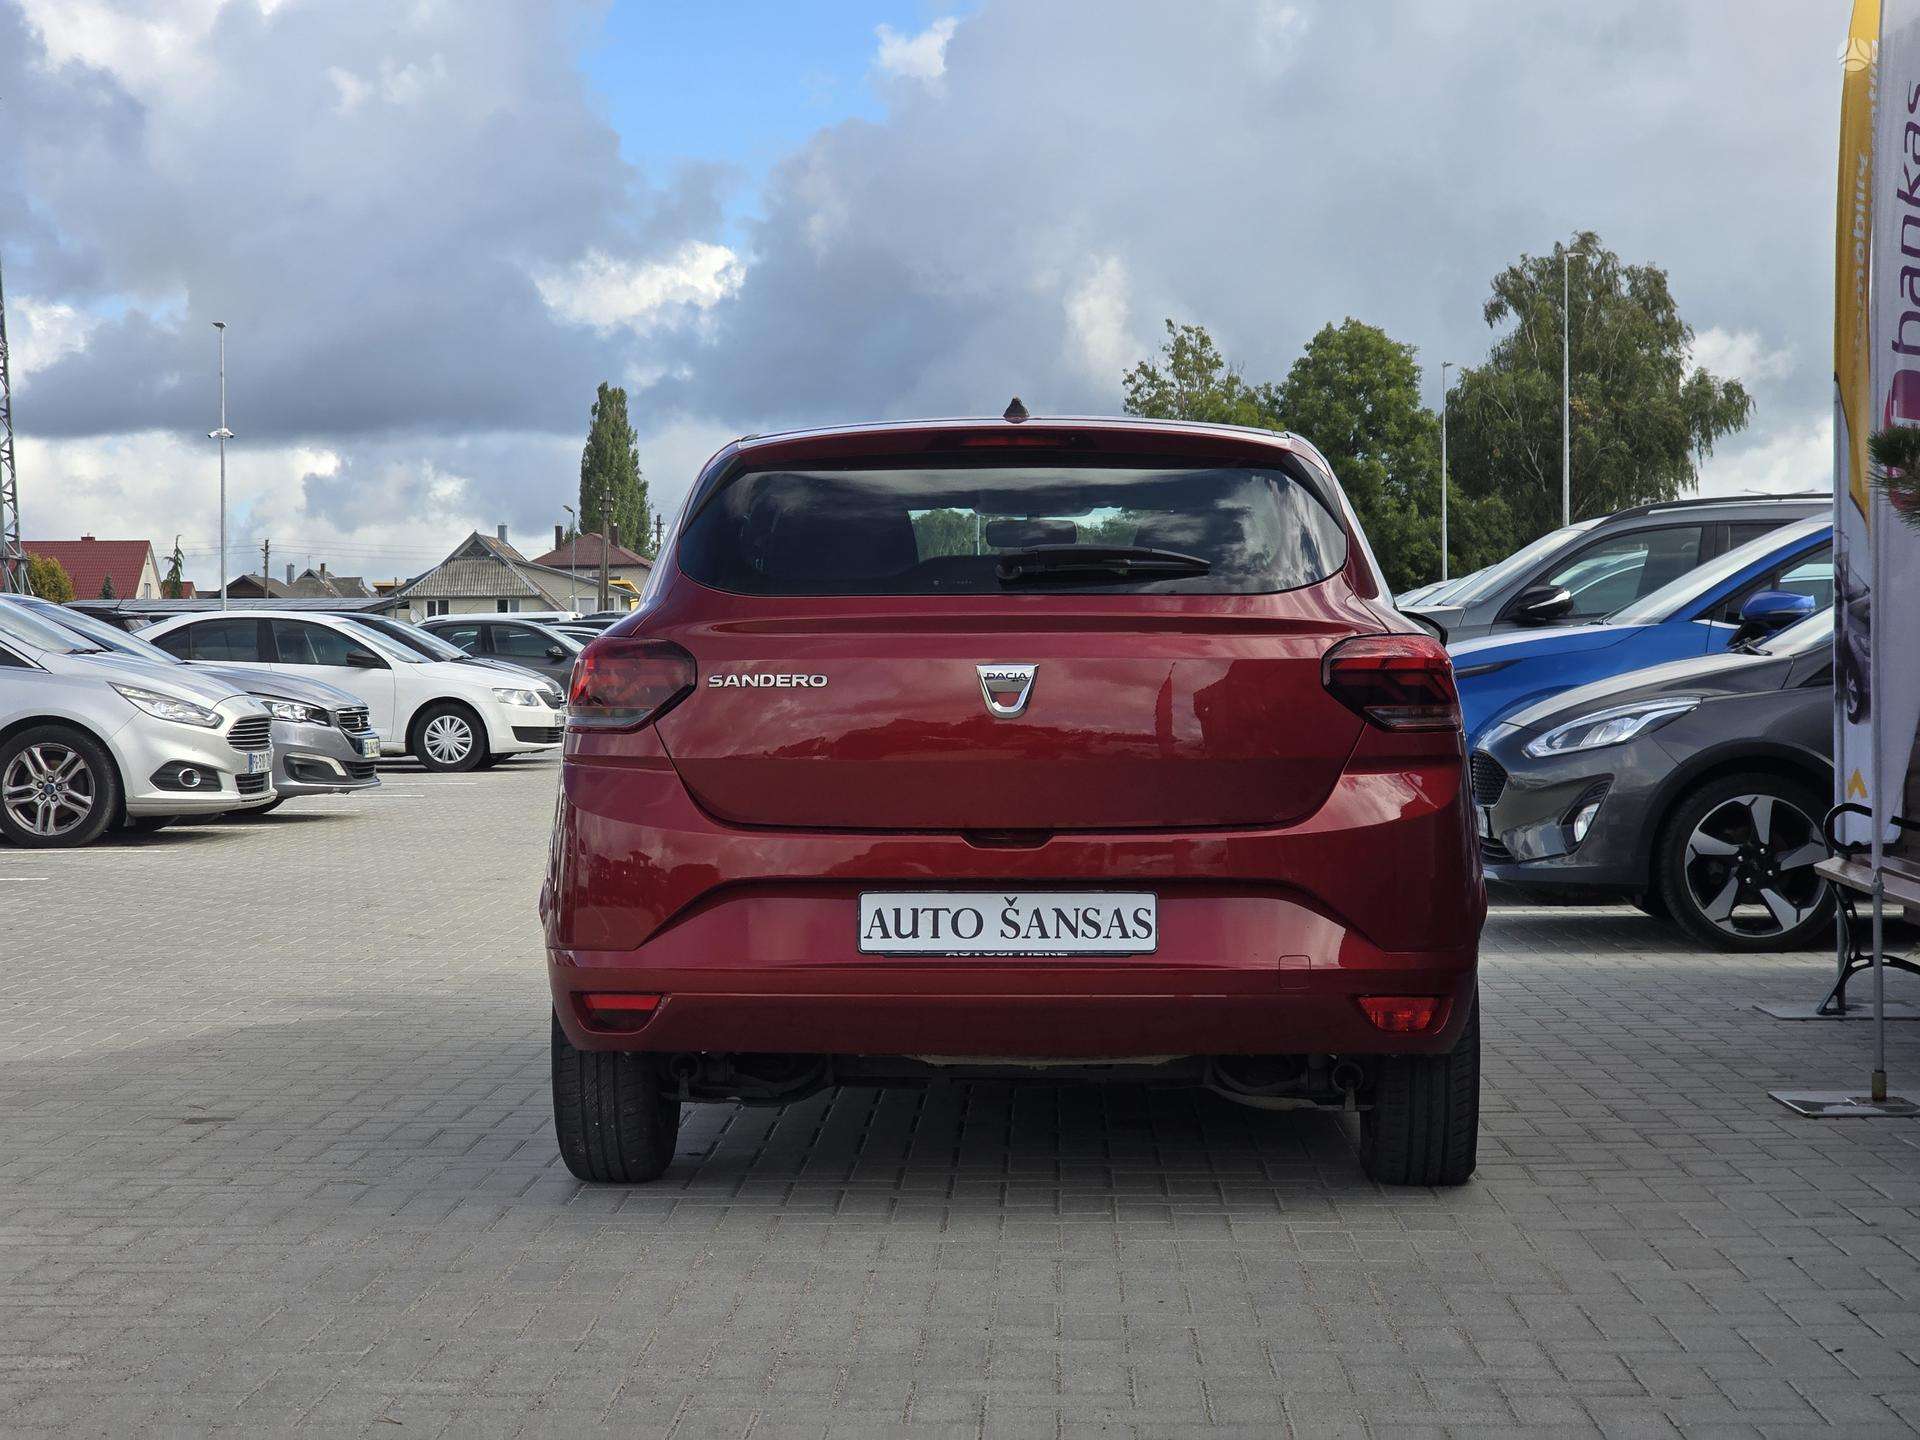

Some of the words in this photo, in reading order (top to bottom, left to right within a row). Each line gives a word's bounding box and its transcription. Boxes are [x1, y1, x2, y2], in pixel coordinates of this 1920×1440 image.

[708, 673, 829, 689] SANDERO
[985, 672, 1029, 680] DACIA
[863, 907, 984, 940] AUTO
[1000, 896, 1153, 940] ŠANSAS
